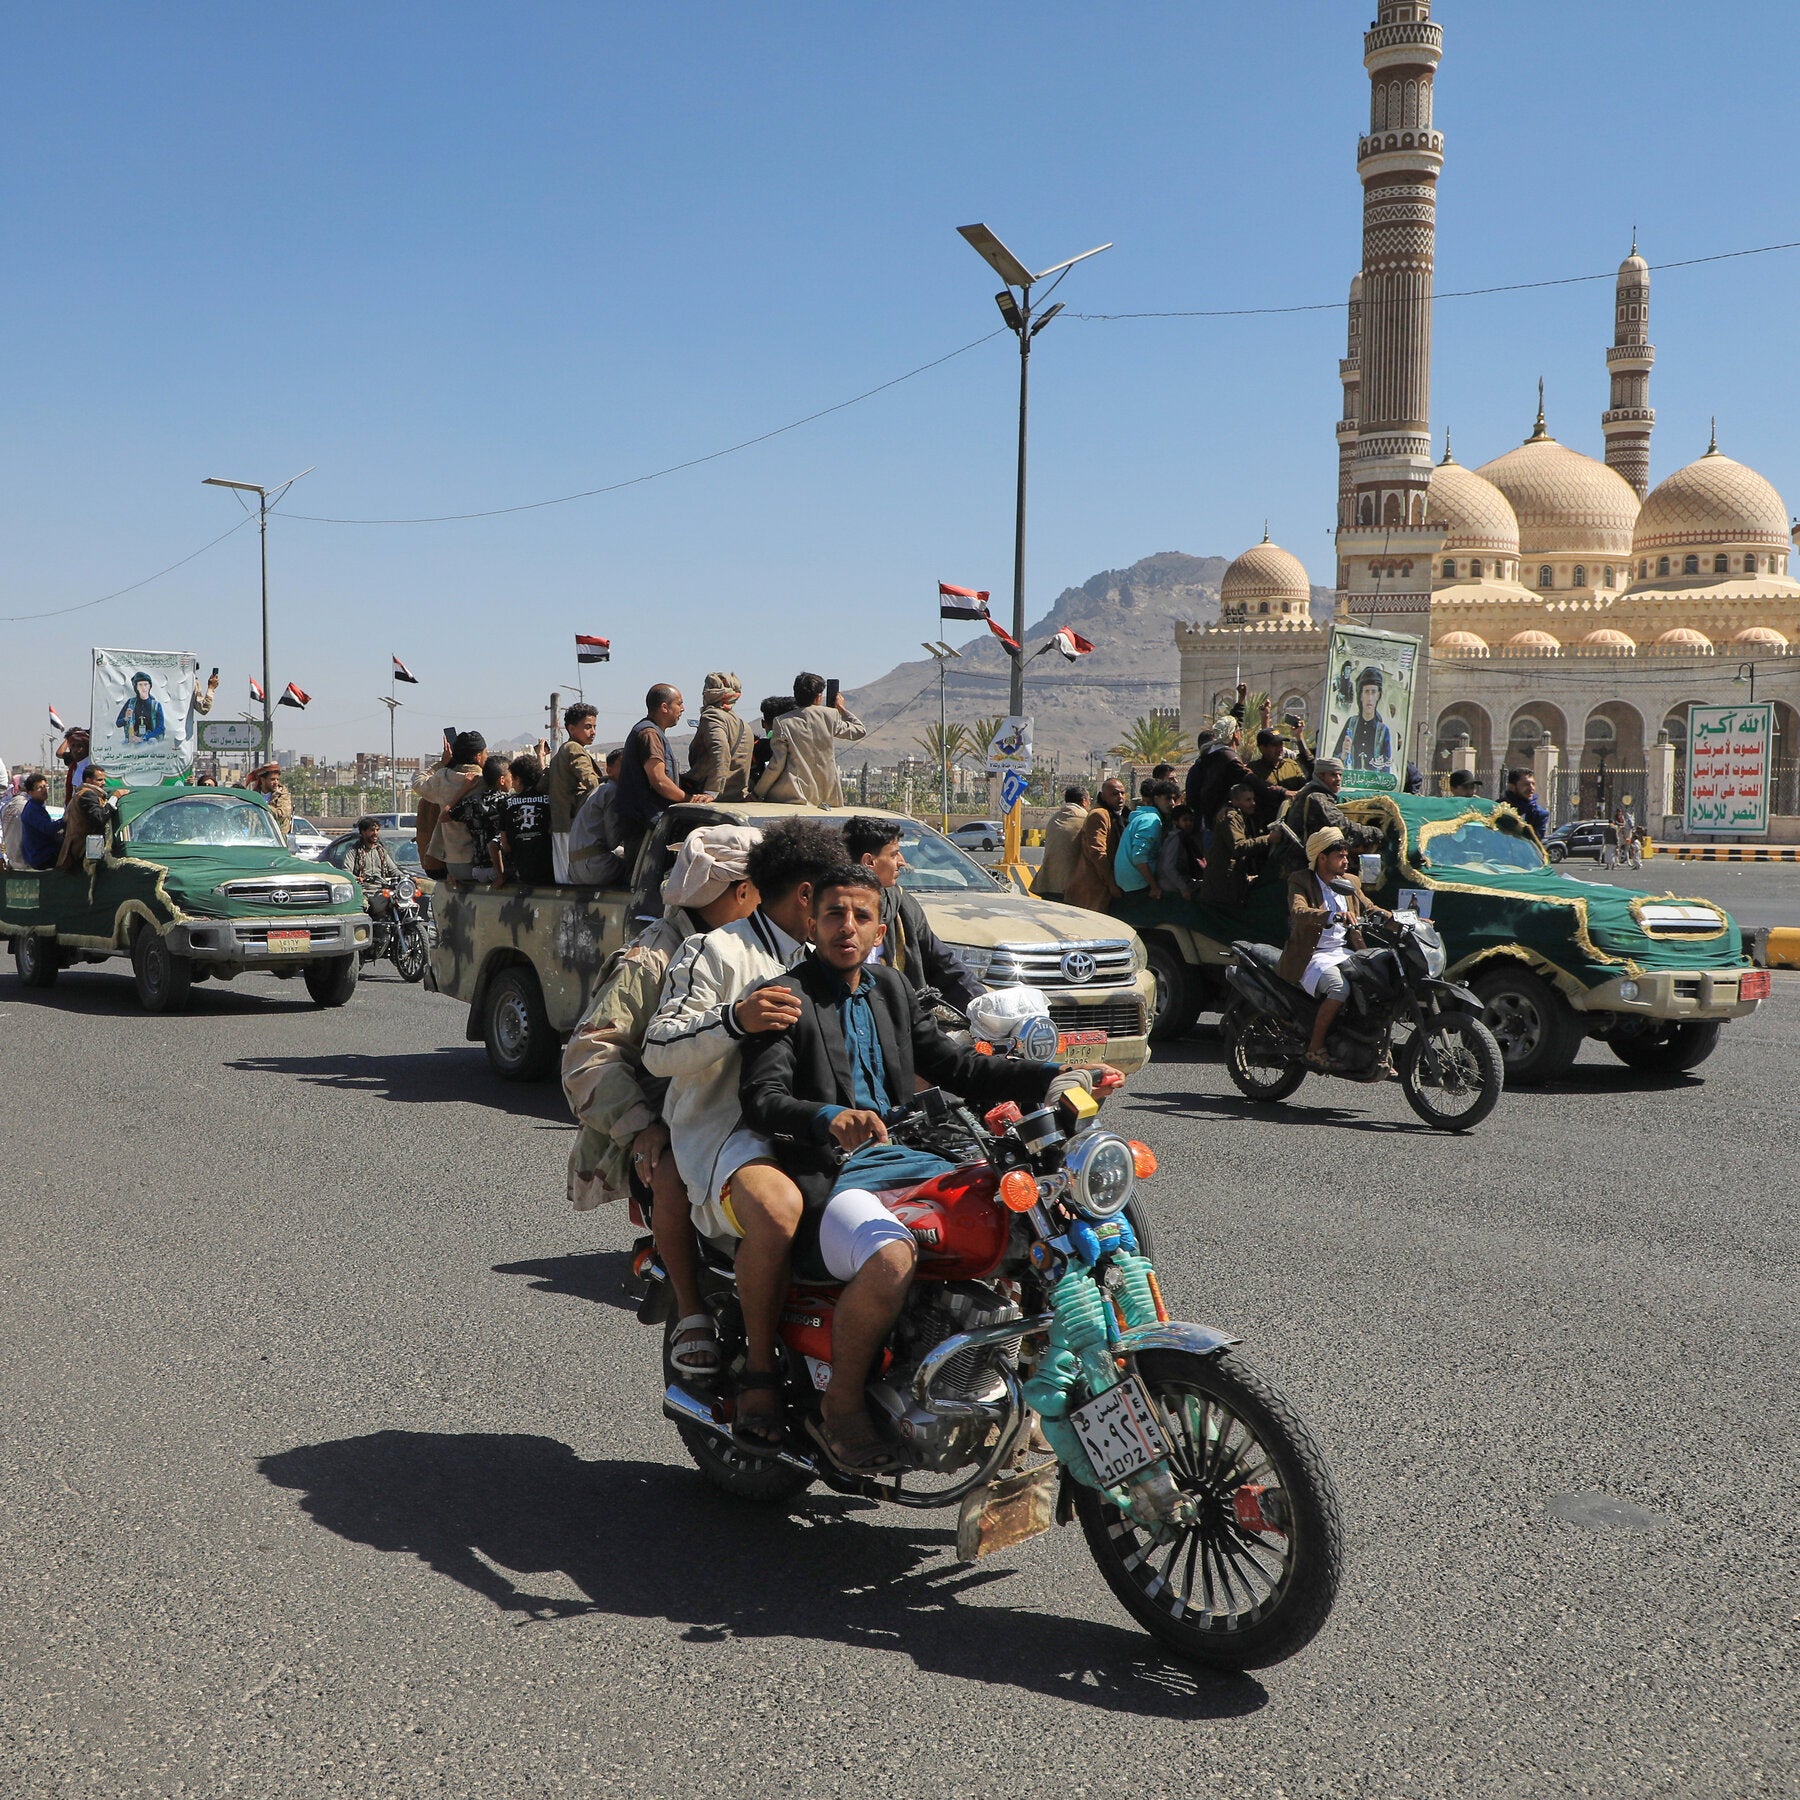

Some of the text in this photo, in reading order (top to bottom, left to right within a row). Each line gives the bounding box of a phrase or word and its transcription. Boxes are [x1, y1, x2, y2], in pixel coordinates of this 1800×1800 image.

[1694, 711, 1766, 740] الله أكبر
[1733, 741, 1764, 757] الموت
[1732, 762, 1763, 778] الموت
[1692, 783, 1718, 799] اليهود
[1738, 783, 1762, 797] اللعنة
[1729, 801, 1762, 825] النصر
[1095, 1392, 1123, 1423] اليمن
[1086, 1414, 1139, 1462] ١٠٩٢
[1104, 1447, 1147, 1481] 1092
